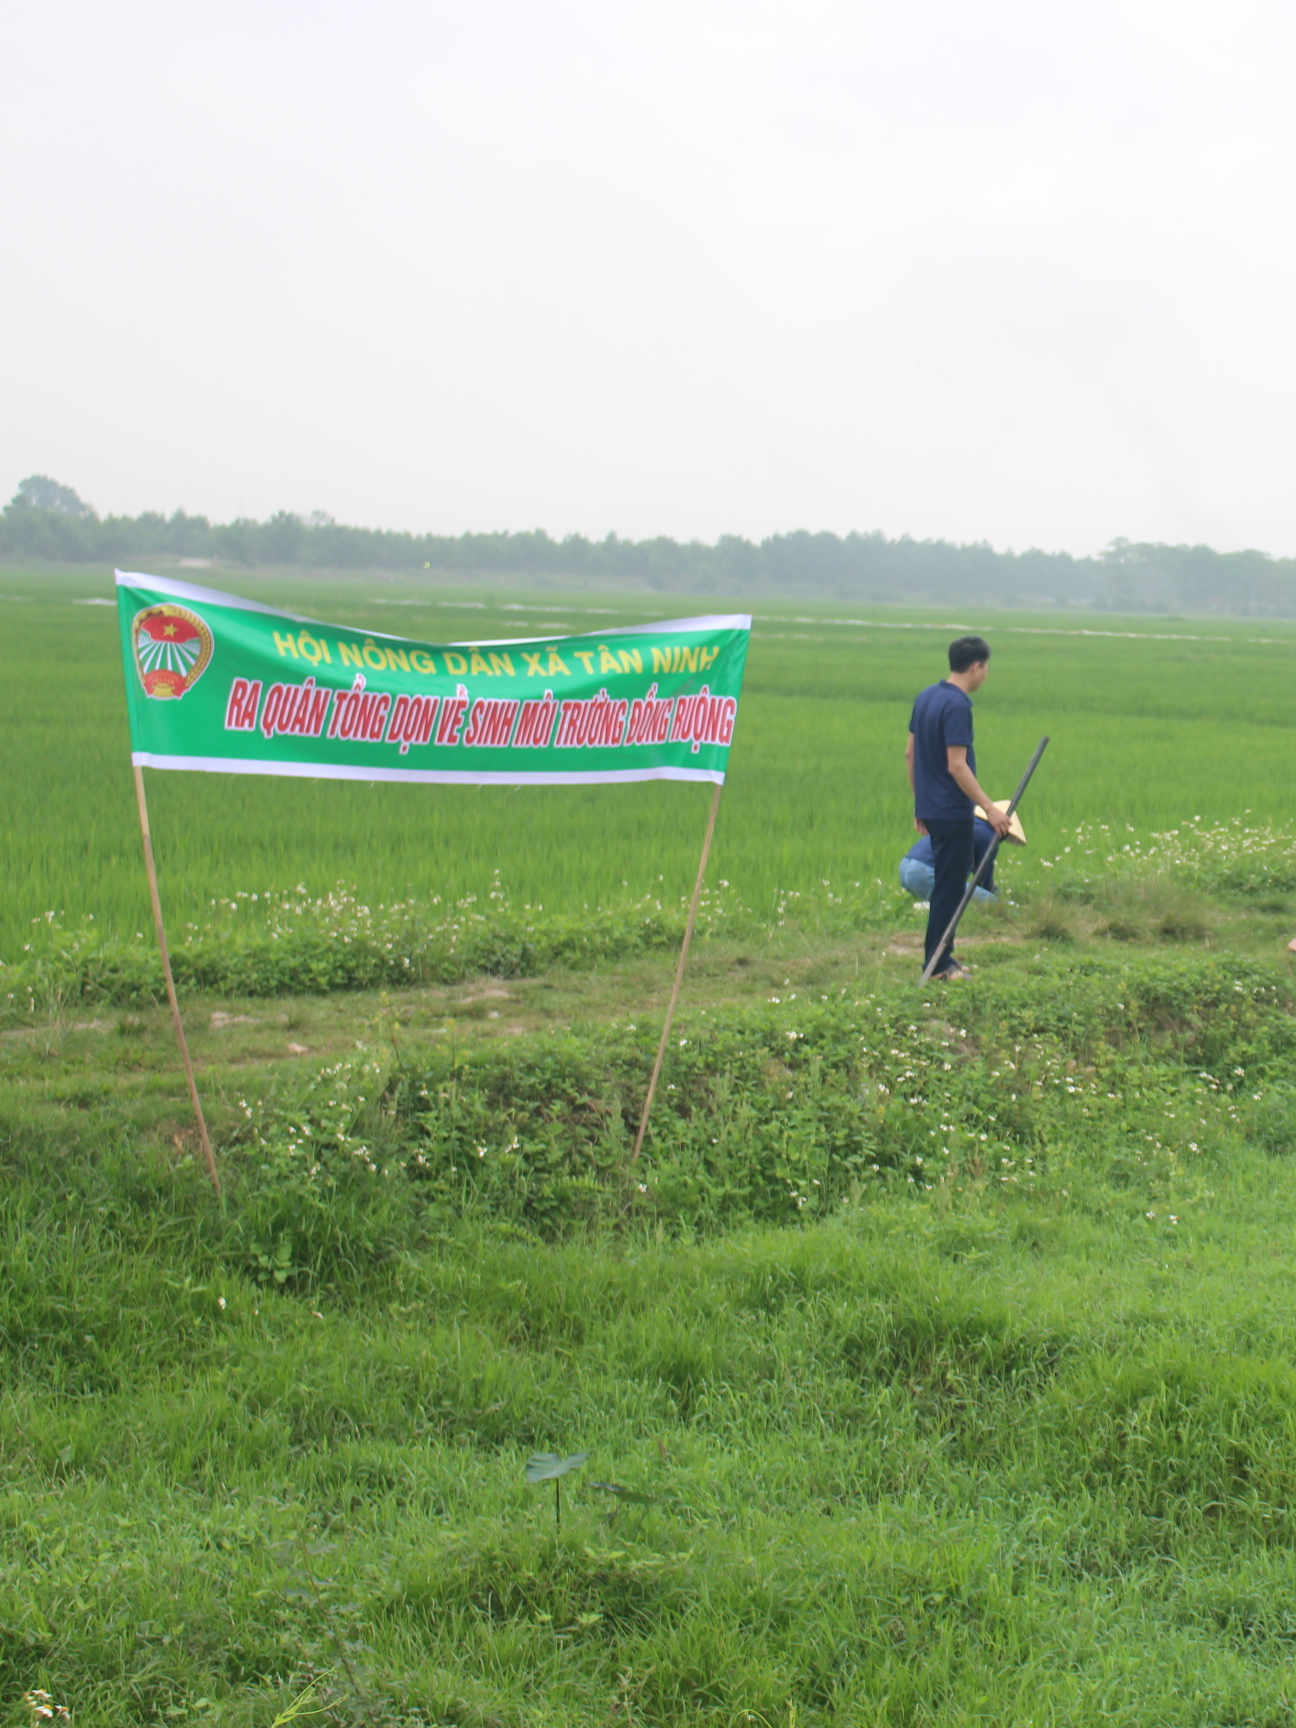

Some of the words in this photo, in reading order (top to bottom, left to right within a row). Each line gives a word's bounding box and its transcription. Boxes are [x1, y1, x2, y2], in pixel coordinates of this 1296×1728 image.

[273, 630, 332, 666] HỘI
[338, 638, 437, 674] NÔNG
[443, 646, 516, 676] DÂN
[521, 647, 572, 677] XÃ
[574, 645, 643, 675] TÂN
[651, 646, 720, 674] NINH
[224, 677, 263, 731] RA
[260, 676, 332, 738] QUÂN
[327, 672, 392, 742] TỔNG
[385, 694, 440, 754] DỌN
[463, 698, 520, 747] SINH
[512, 690, 559, 747] MÔI
[553, 688, 628, 747] TRƯỜNG
[668, 684, 738, 754] RUỘNG
